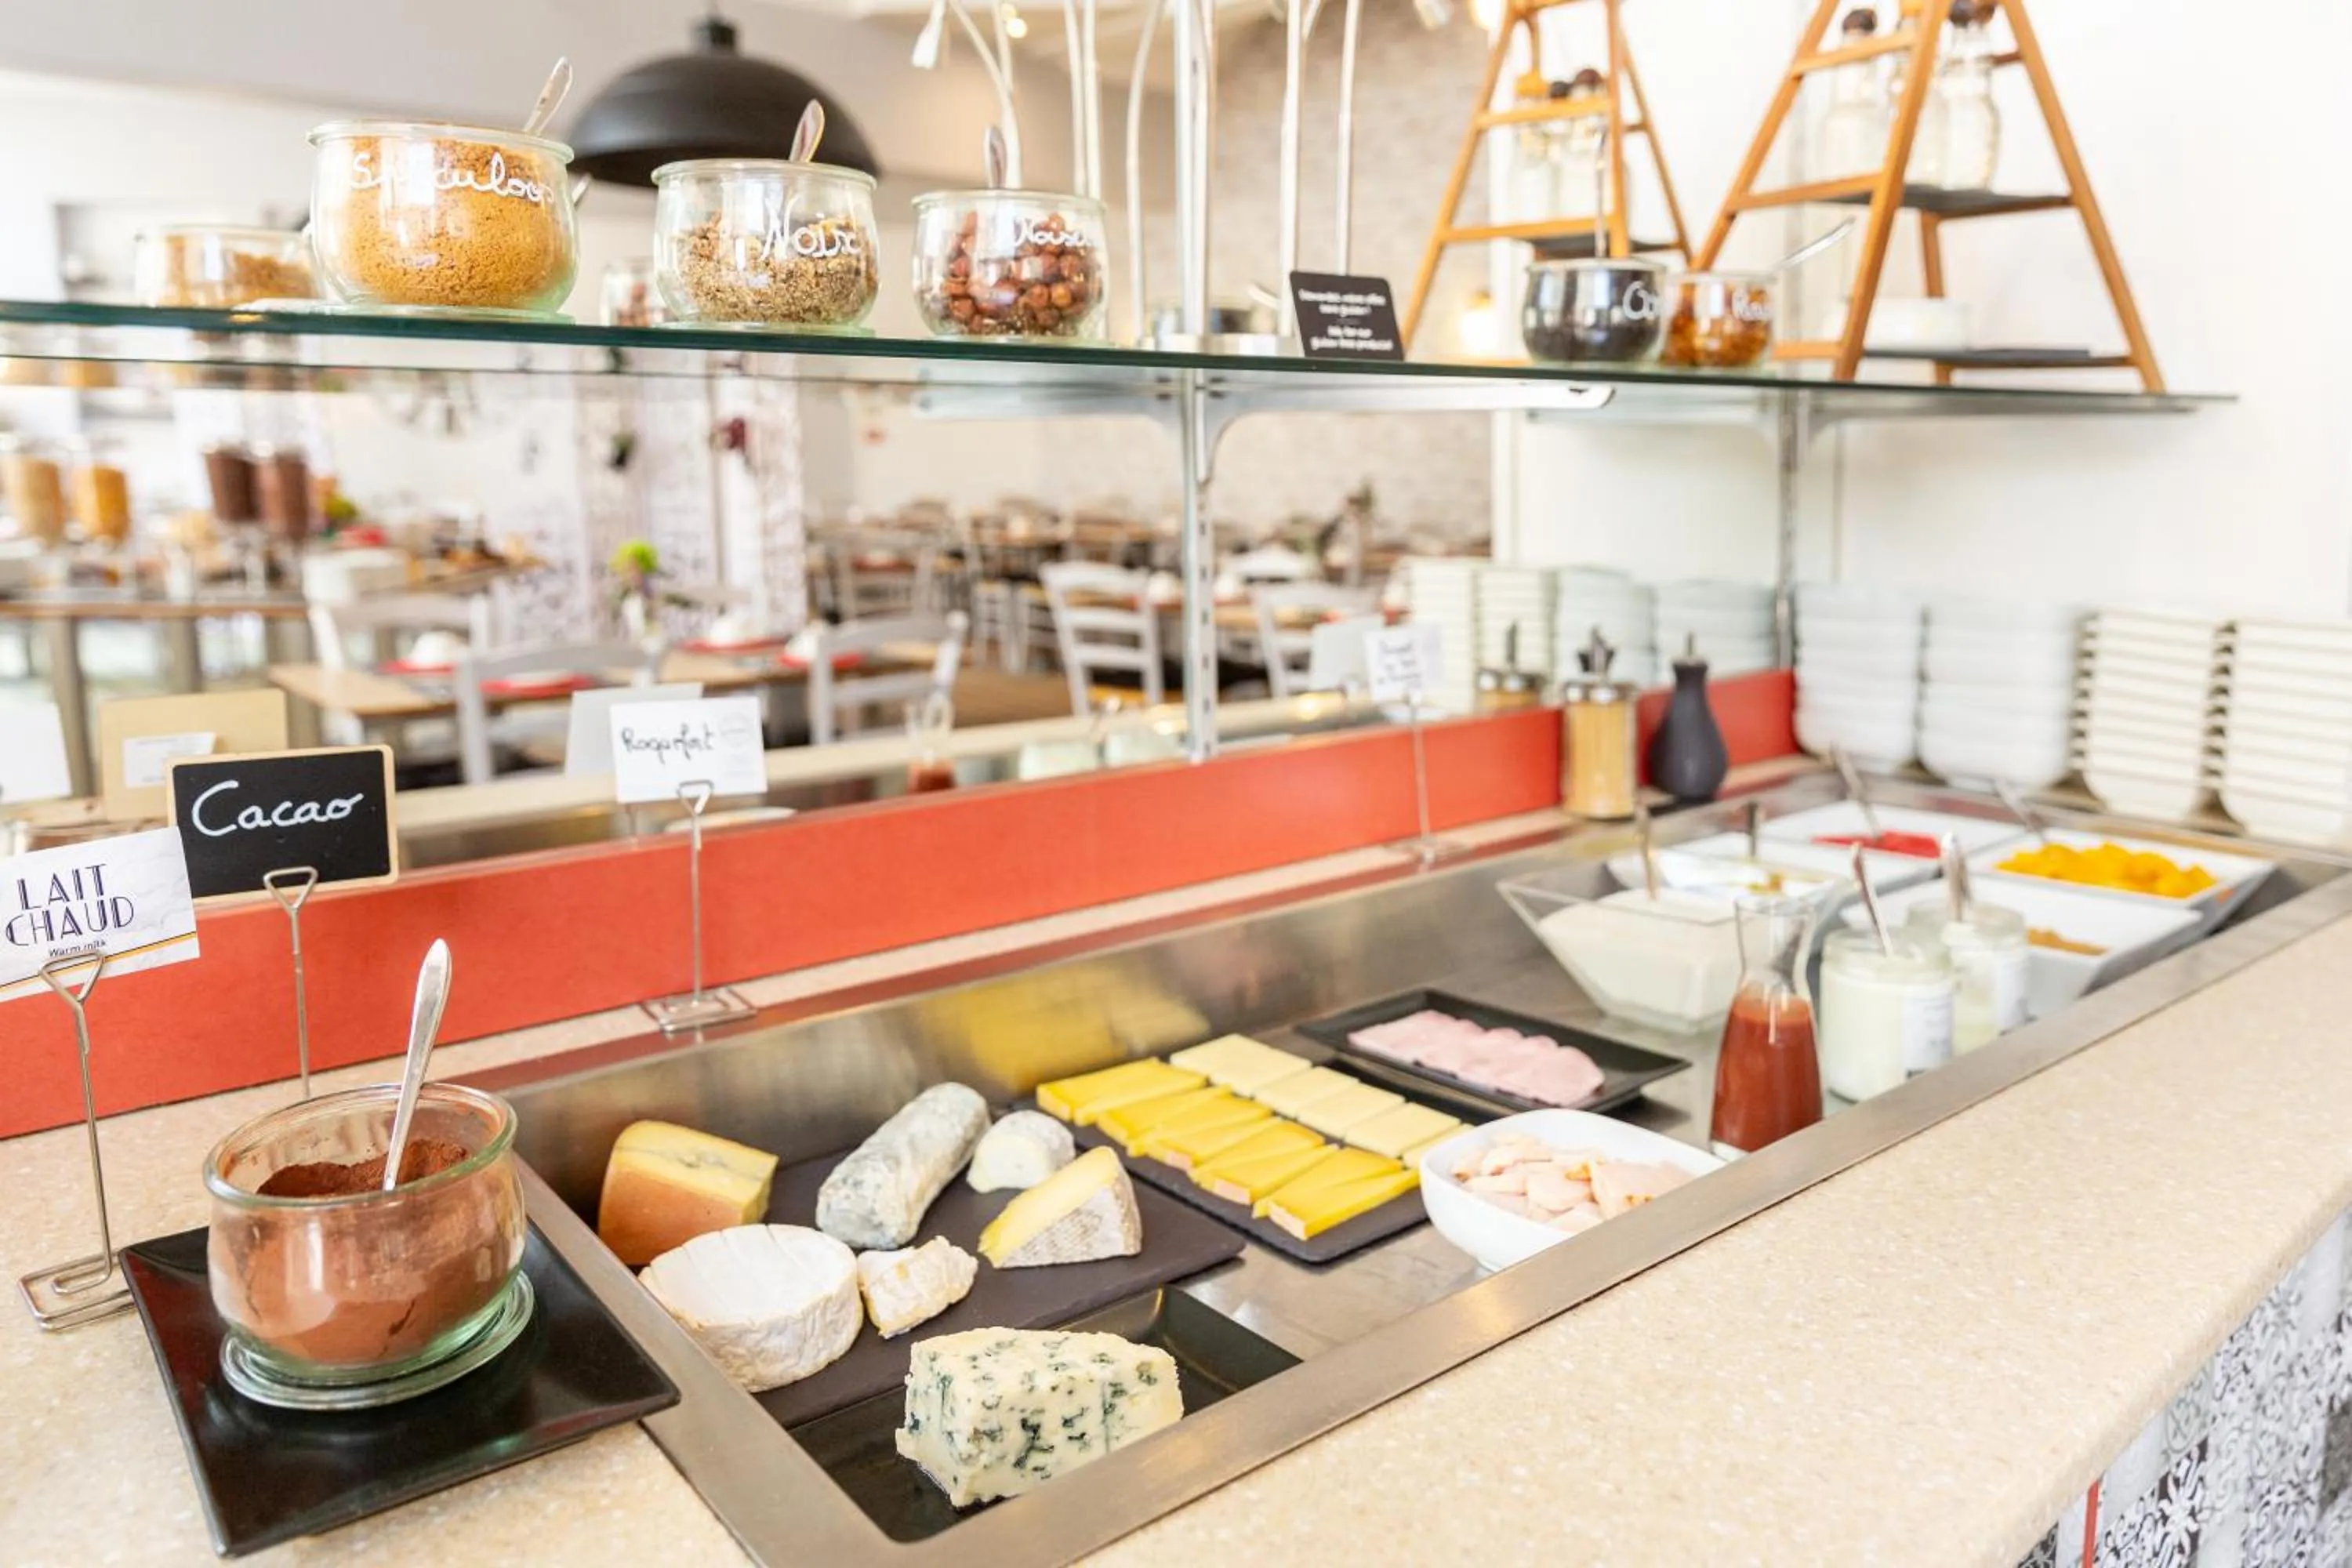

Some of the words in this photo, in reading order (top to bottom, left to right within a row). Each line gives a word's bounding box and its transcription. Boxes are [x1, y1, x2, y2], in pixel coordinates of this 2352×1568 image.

[191, 779, 365, 837] Cacao
[16, 863, 108, 911] LAIT
[5, 895, 136, 947] CHAUD
[49, 946, 82, 957] Warm
